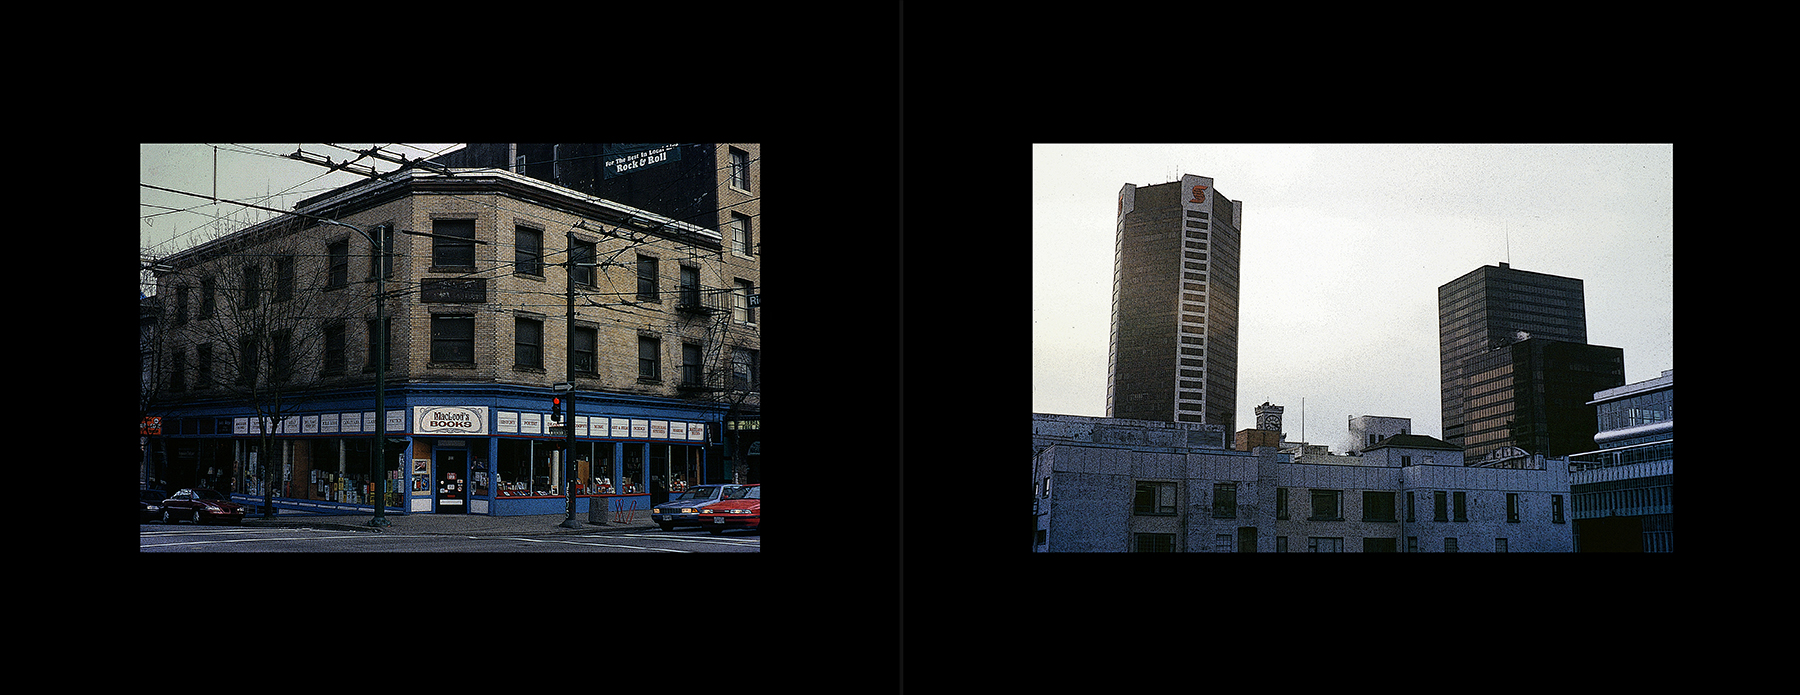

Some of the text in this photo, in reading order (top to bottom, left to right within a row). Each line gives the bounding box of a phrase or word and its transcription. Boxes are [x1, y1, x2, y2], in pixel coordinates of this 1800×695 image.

[617, 152, 666, 172] Rock & Roll
[433, 411, 470, 421] MacLeod's
[430, 420, 472, 428] BOOKS
